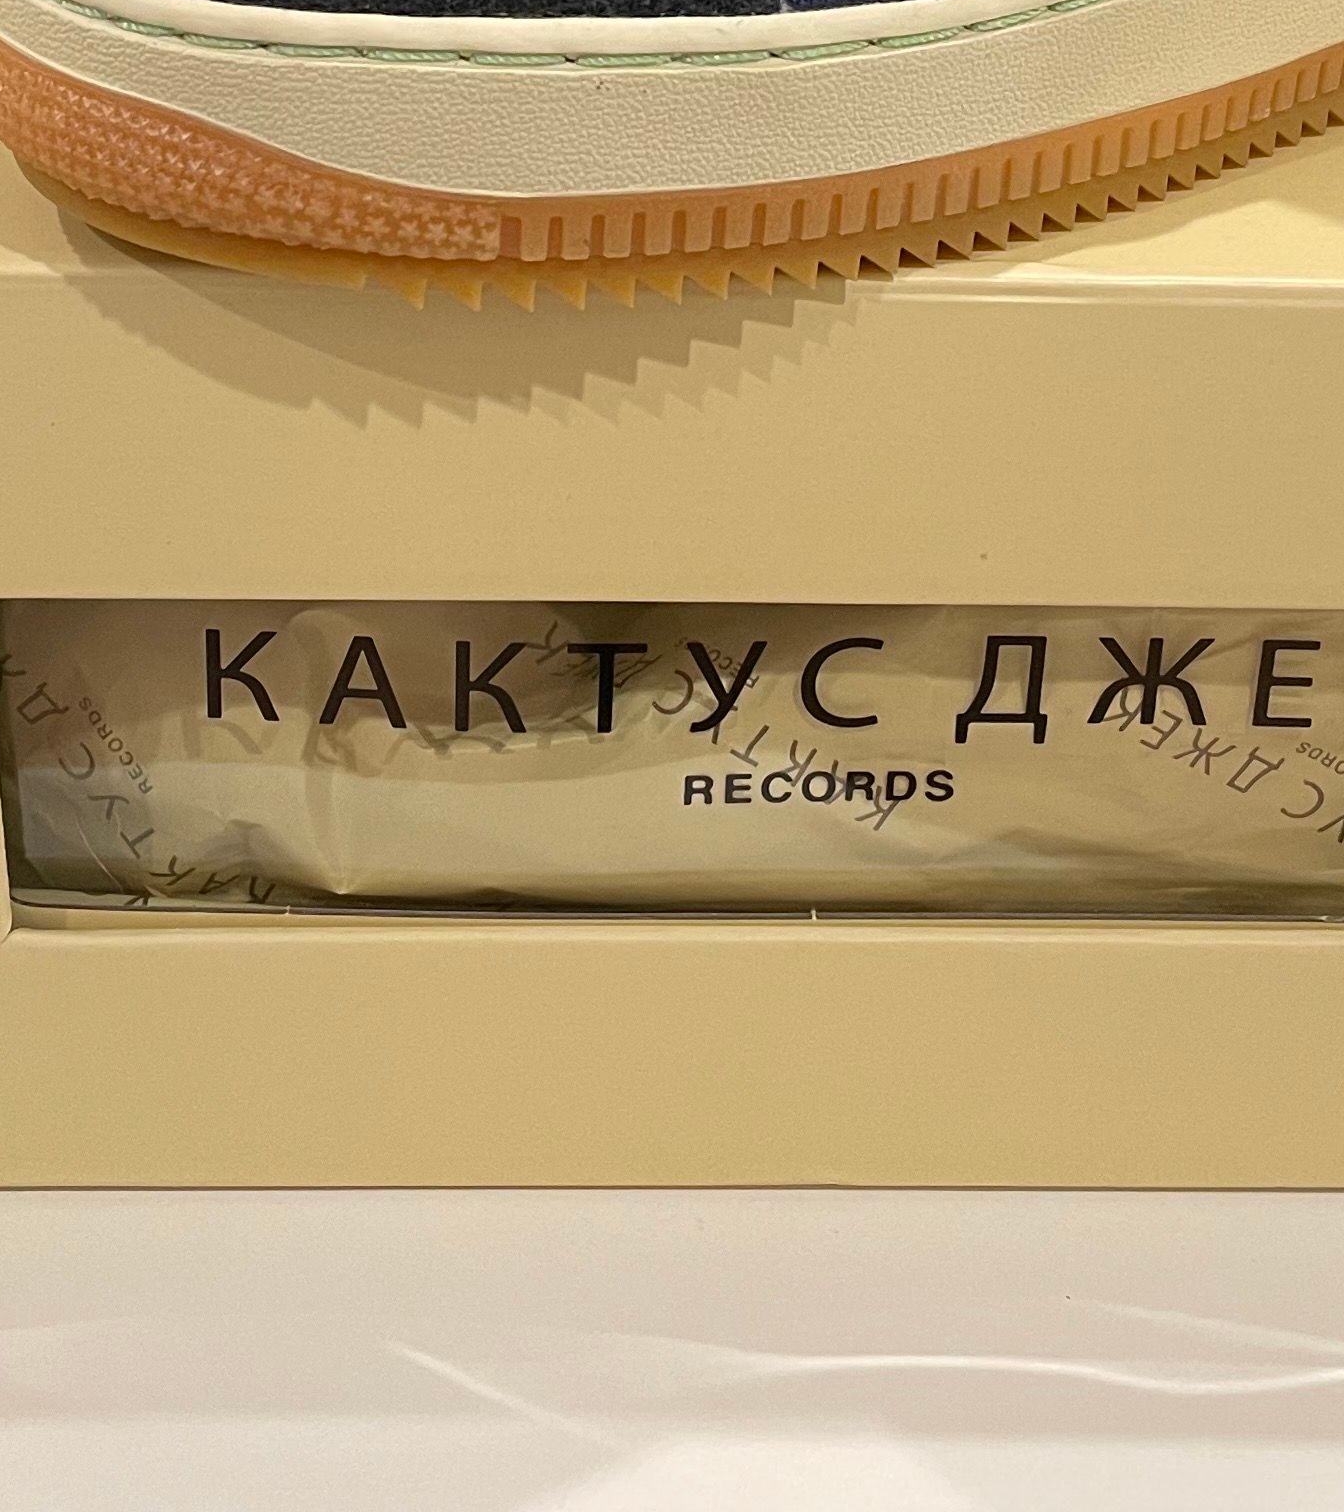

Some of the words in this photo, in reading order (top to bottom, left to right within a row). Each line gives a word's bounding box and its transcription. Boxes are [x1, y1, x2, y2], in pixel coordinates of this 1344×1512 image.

[205, 628, 885, 734] КАКТУС
[77, 696, 155, 796] RECORDS
[683, 770, 955, 807] RECORDS
